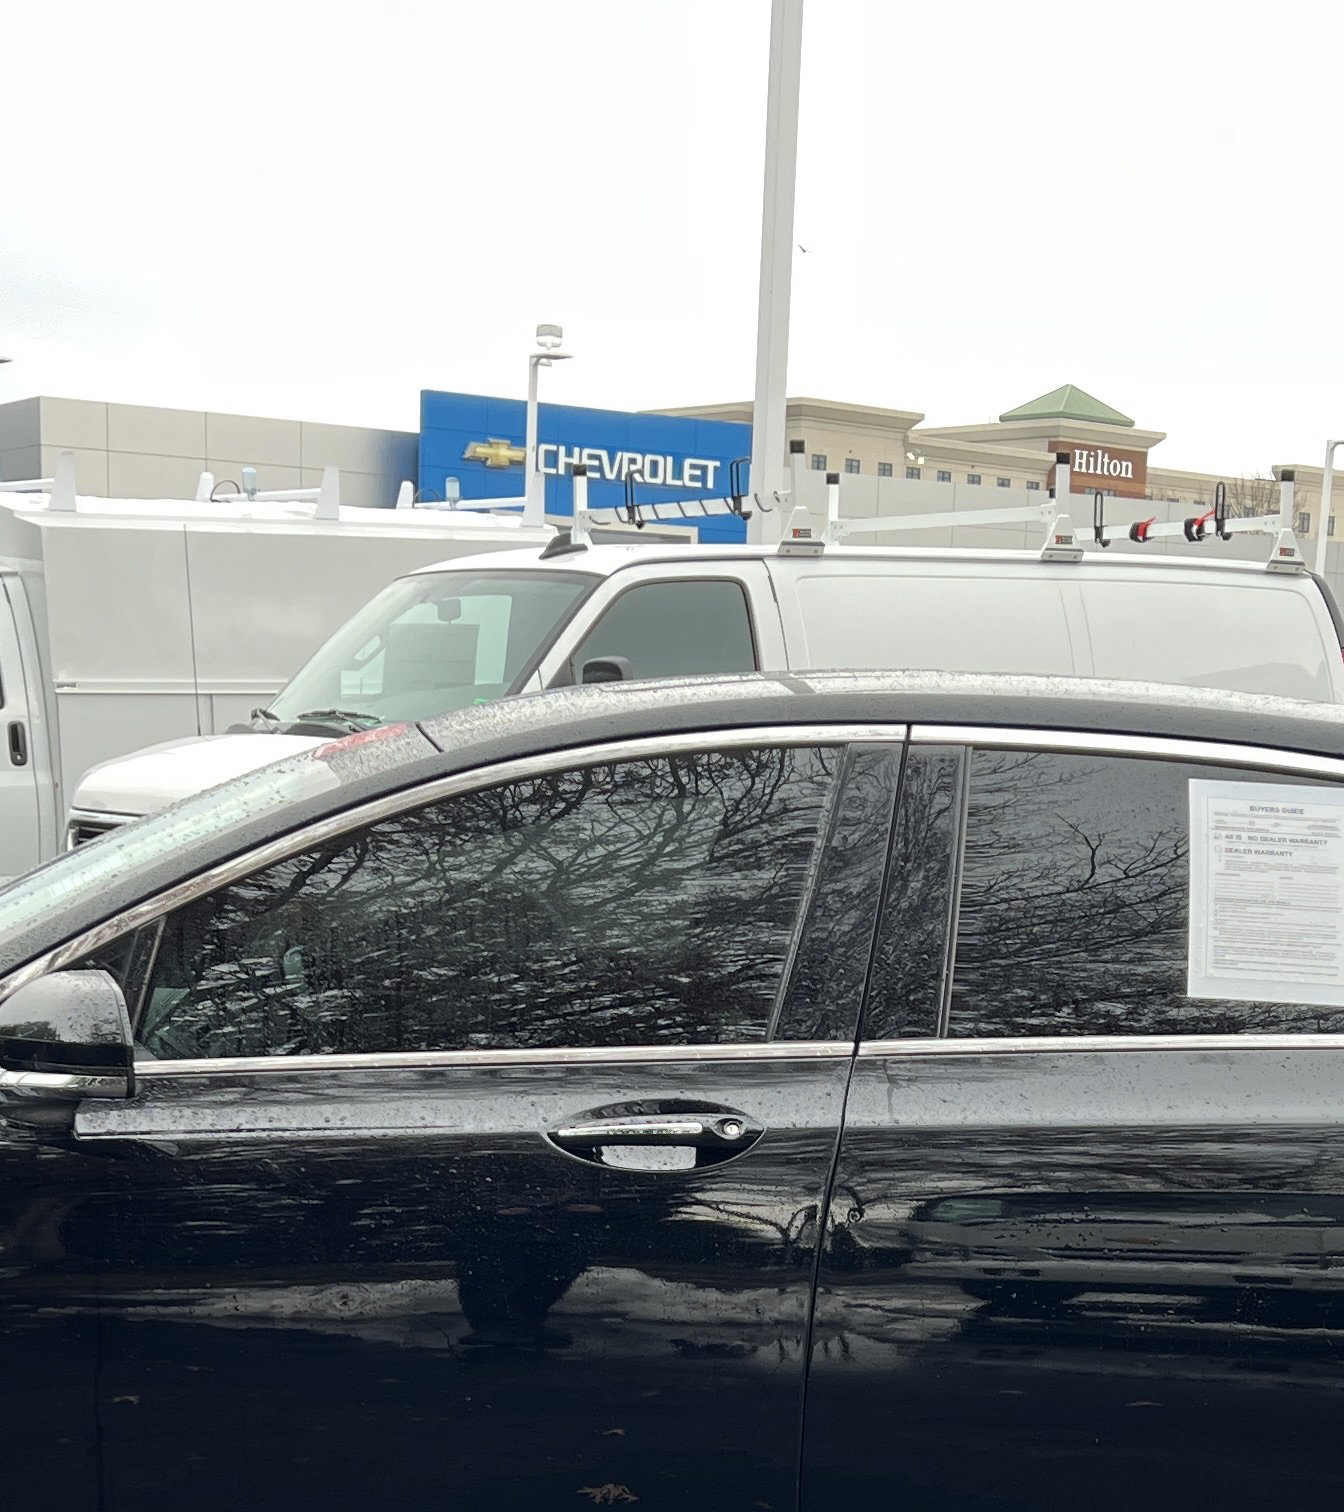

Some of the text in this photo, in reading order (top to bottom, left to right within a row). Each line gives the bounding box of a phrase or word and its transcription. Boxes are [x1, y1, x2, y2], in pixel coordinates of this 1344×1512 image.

[537, 443, 721, 489] CHEVROLET
[1073, 449, 1133, 478] Hilton
[1288, 837, 1328, 846] WARRANTY
[1224, 847, 1253, 855] DEALER
[1253, 848, 1294, 857] WARRANTY
